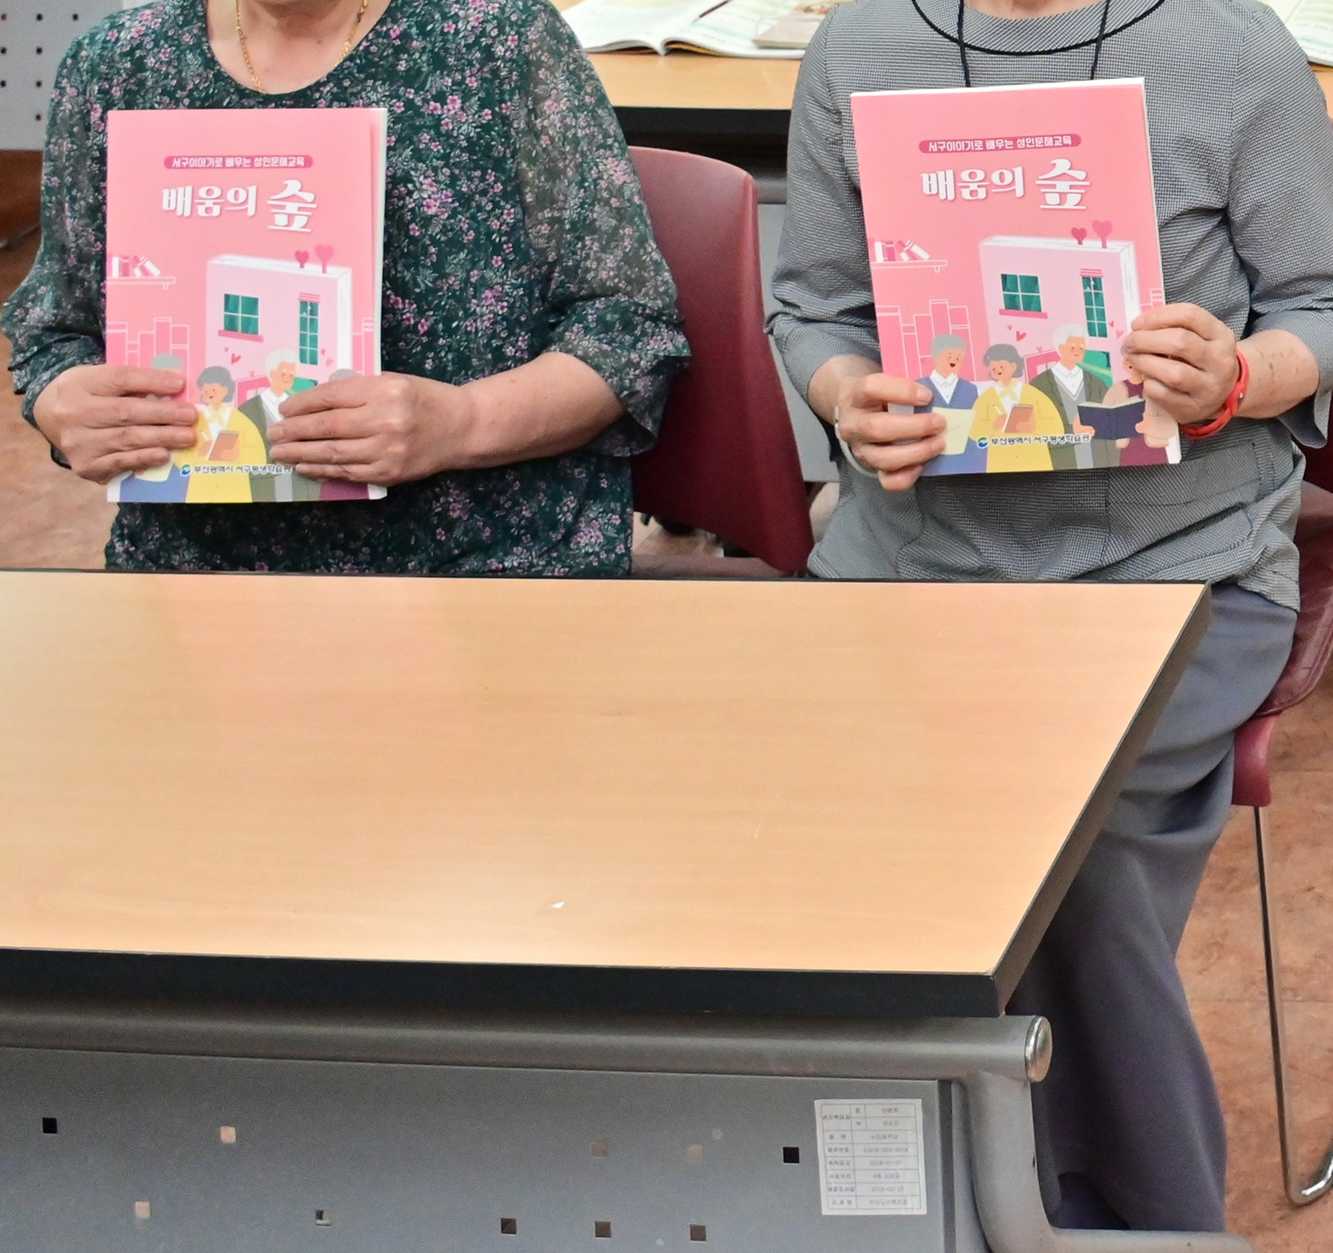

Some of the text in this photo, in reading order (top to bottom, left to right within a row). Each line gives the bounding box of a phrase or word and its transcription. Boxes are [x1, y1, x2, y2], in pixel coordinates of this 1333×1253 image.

[929, 135, 1072, 152] 서구이야기로 배우는 성인문해교육
[172, 156, 305, 168] 서구이야기로 배우는 성인문해교육
[920, 158, 1091, 210] 배움의 숲
[161, 179, 318, 232] 배움의 숲
